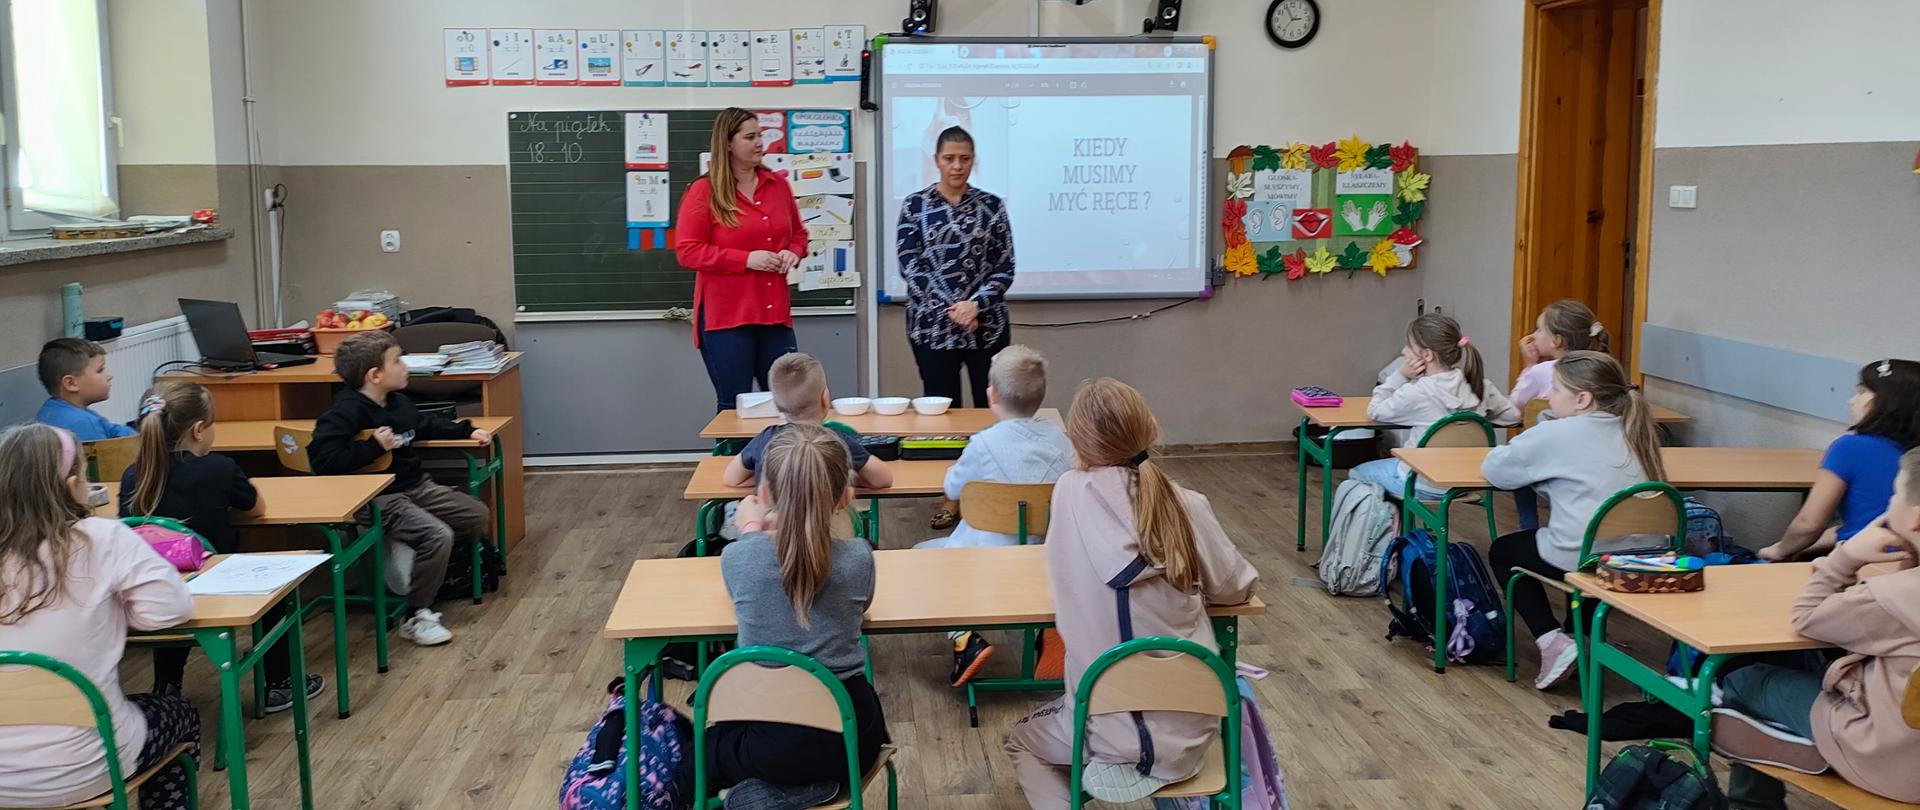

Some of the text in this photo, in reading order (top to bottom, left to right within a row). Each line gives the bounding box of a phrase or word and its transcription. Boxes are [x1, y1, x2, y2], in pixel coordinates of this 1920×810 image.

[520, 113, 548, 132] Na
[1073, 138, 1127, 157] KIEDY
[1063, 164, 1137, 184] MUSIMY
[1048, 187, 1152, 215] MYĆ RĘCE ?
